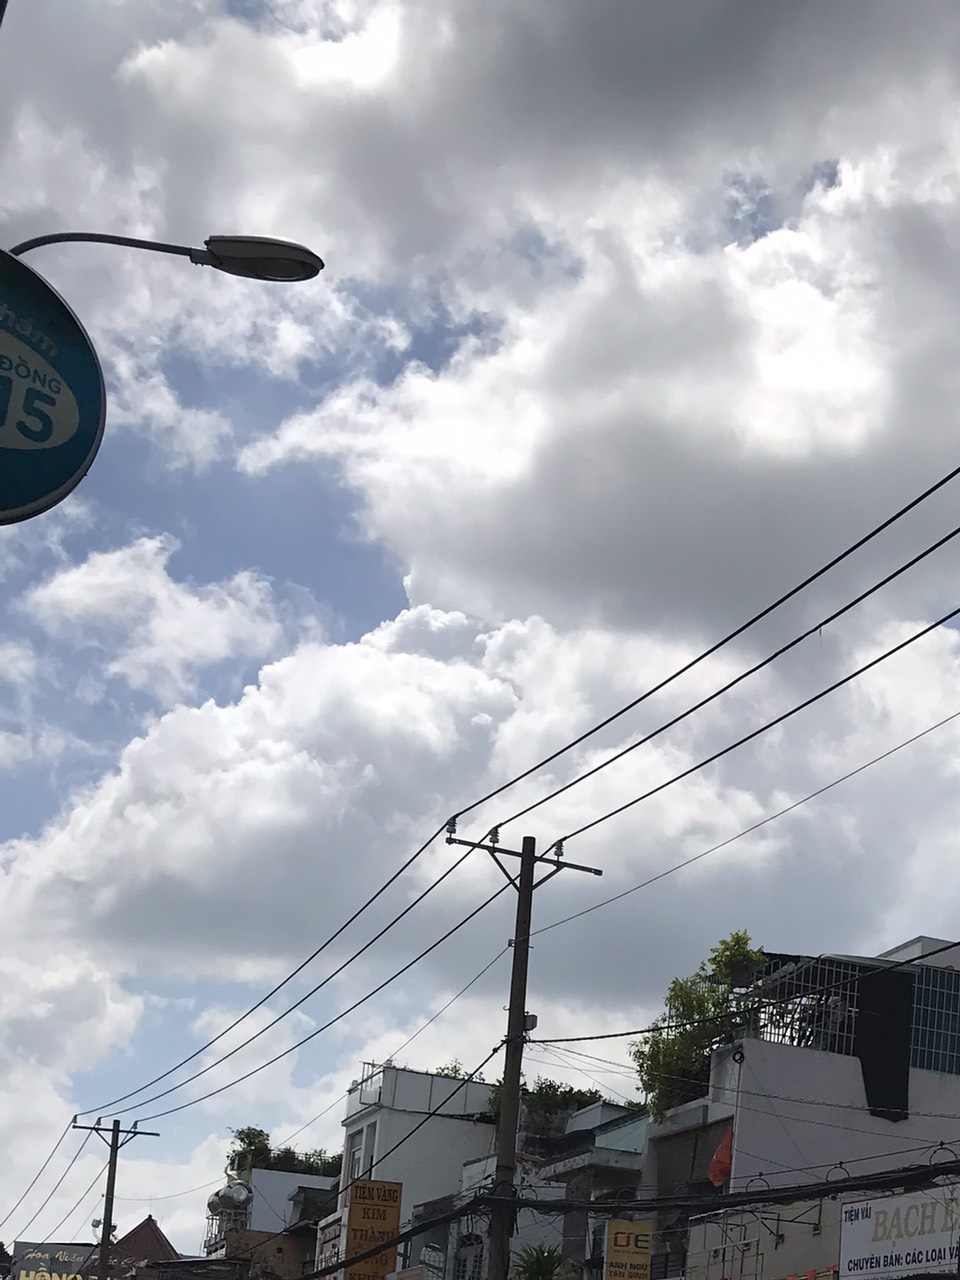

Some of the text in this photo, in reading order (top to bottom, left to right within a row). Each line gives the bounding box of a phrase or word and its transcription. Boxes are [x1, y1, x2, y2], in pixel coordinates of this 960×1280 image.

[376, 1184, 398, 1203] VÀNG
[362, 1207, 386, 1221] KIM
[844, 1206, 859, 1226] TIỆM
[848, 1251, 881, 1273] CHUYÊN
[905, 1246, 924, 1265] CÁC
[925, 1245, 947, 1265] LOẠI
